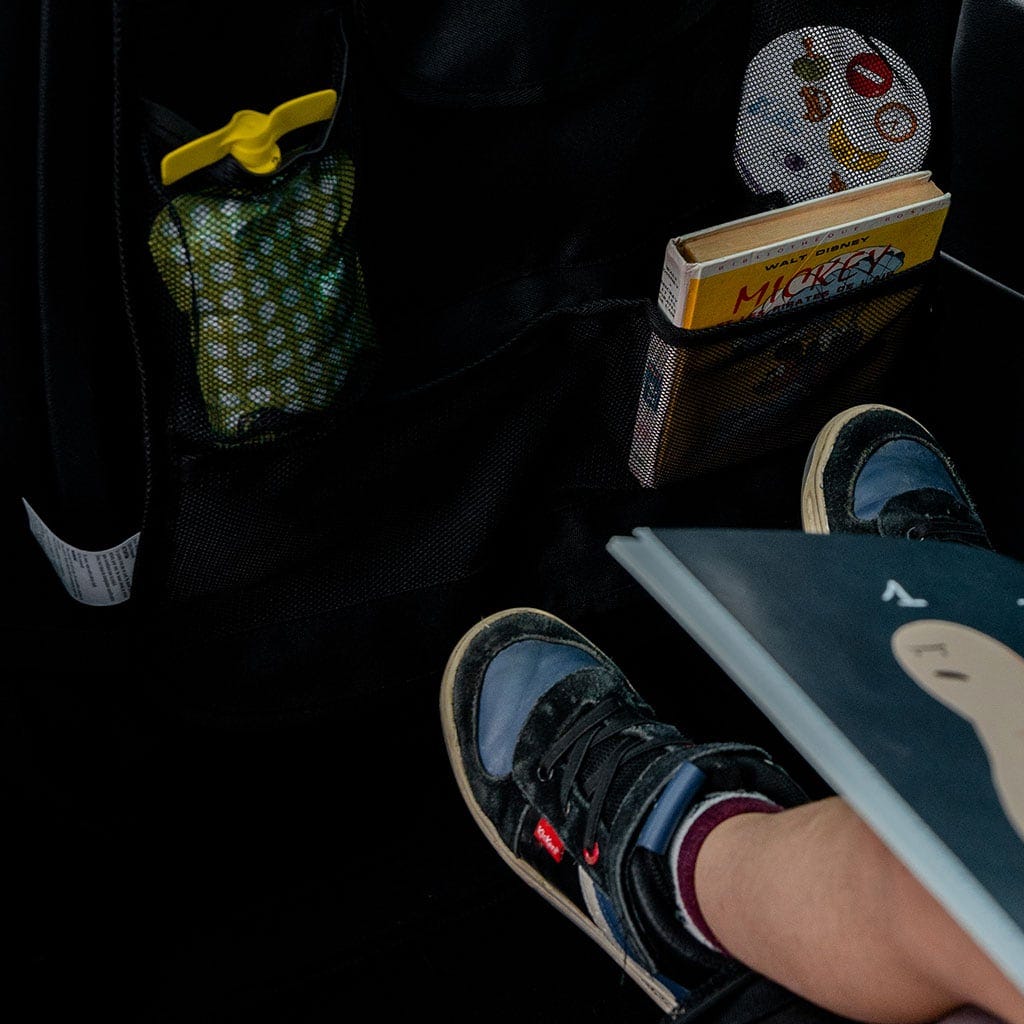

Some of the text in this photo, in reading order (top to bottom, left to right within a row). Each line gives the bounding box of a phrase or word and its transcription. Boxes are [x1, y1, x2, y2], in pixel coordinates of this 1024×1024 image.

[733, 243, 891, 314] MICKEY
[765, 236, 870, 271] WALT DISNEY
